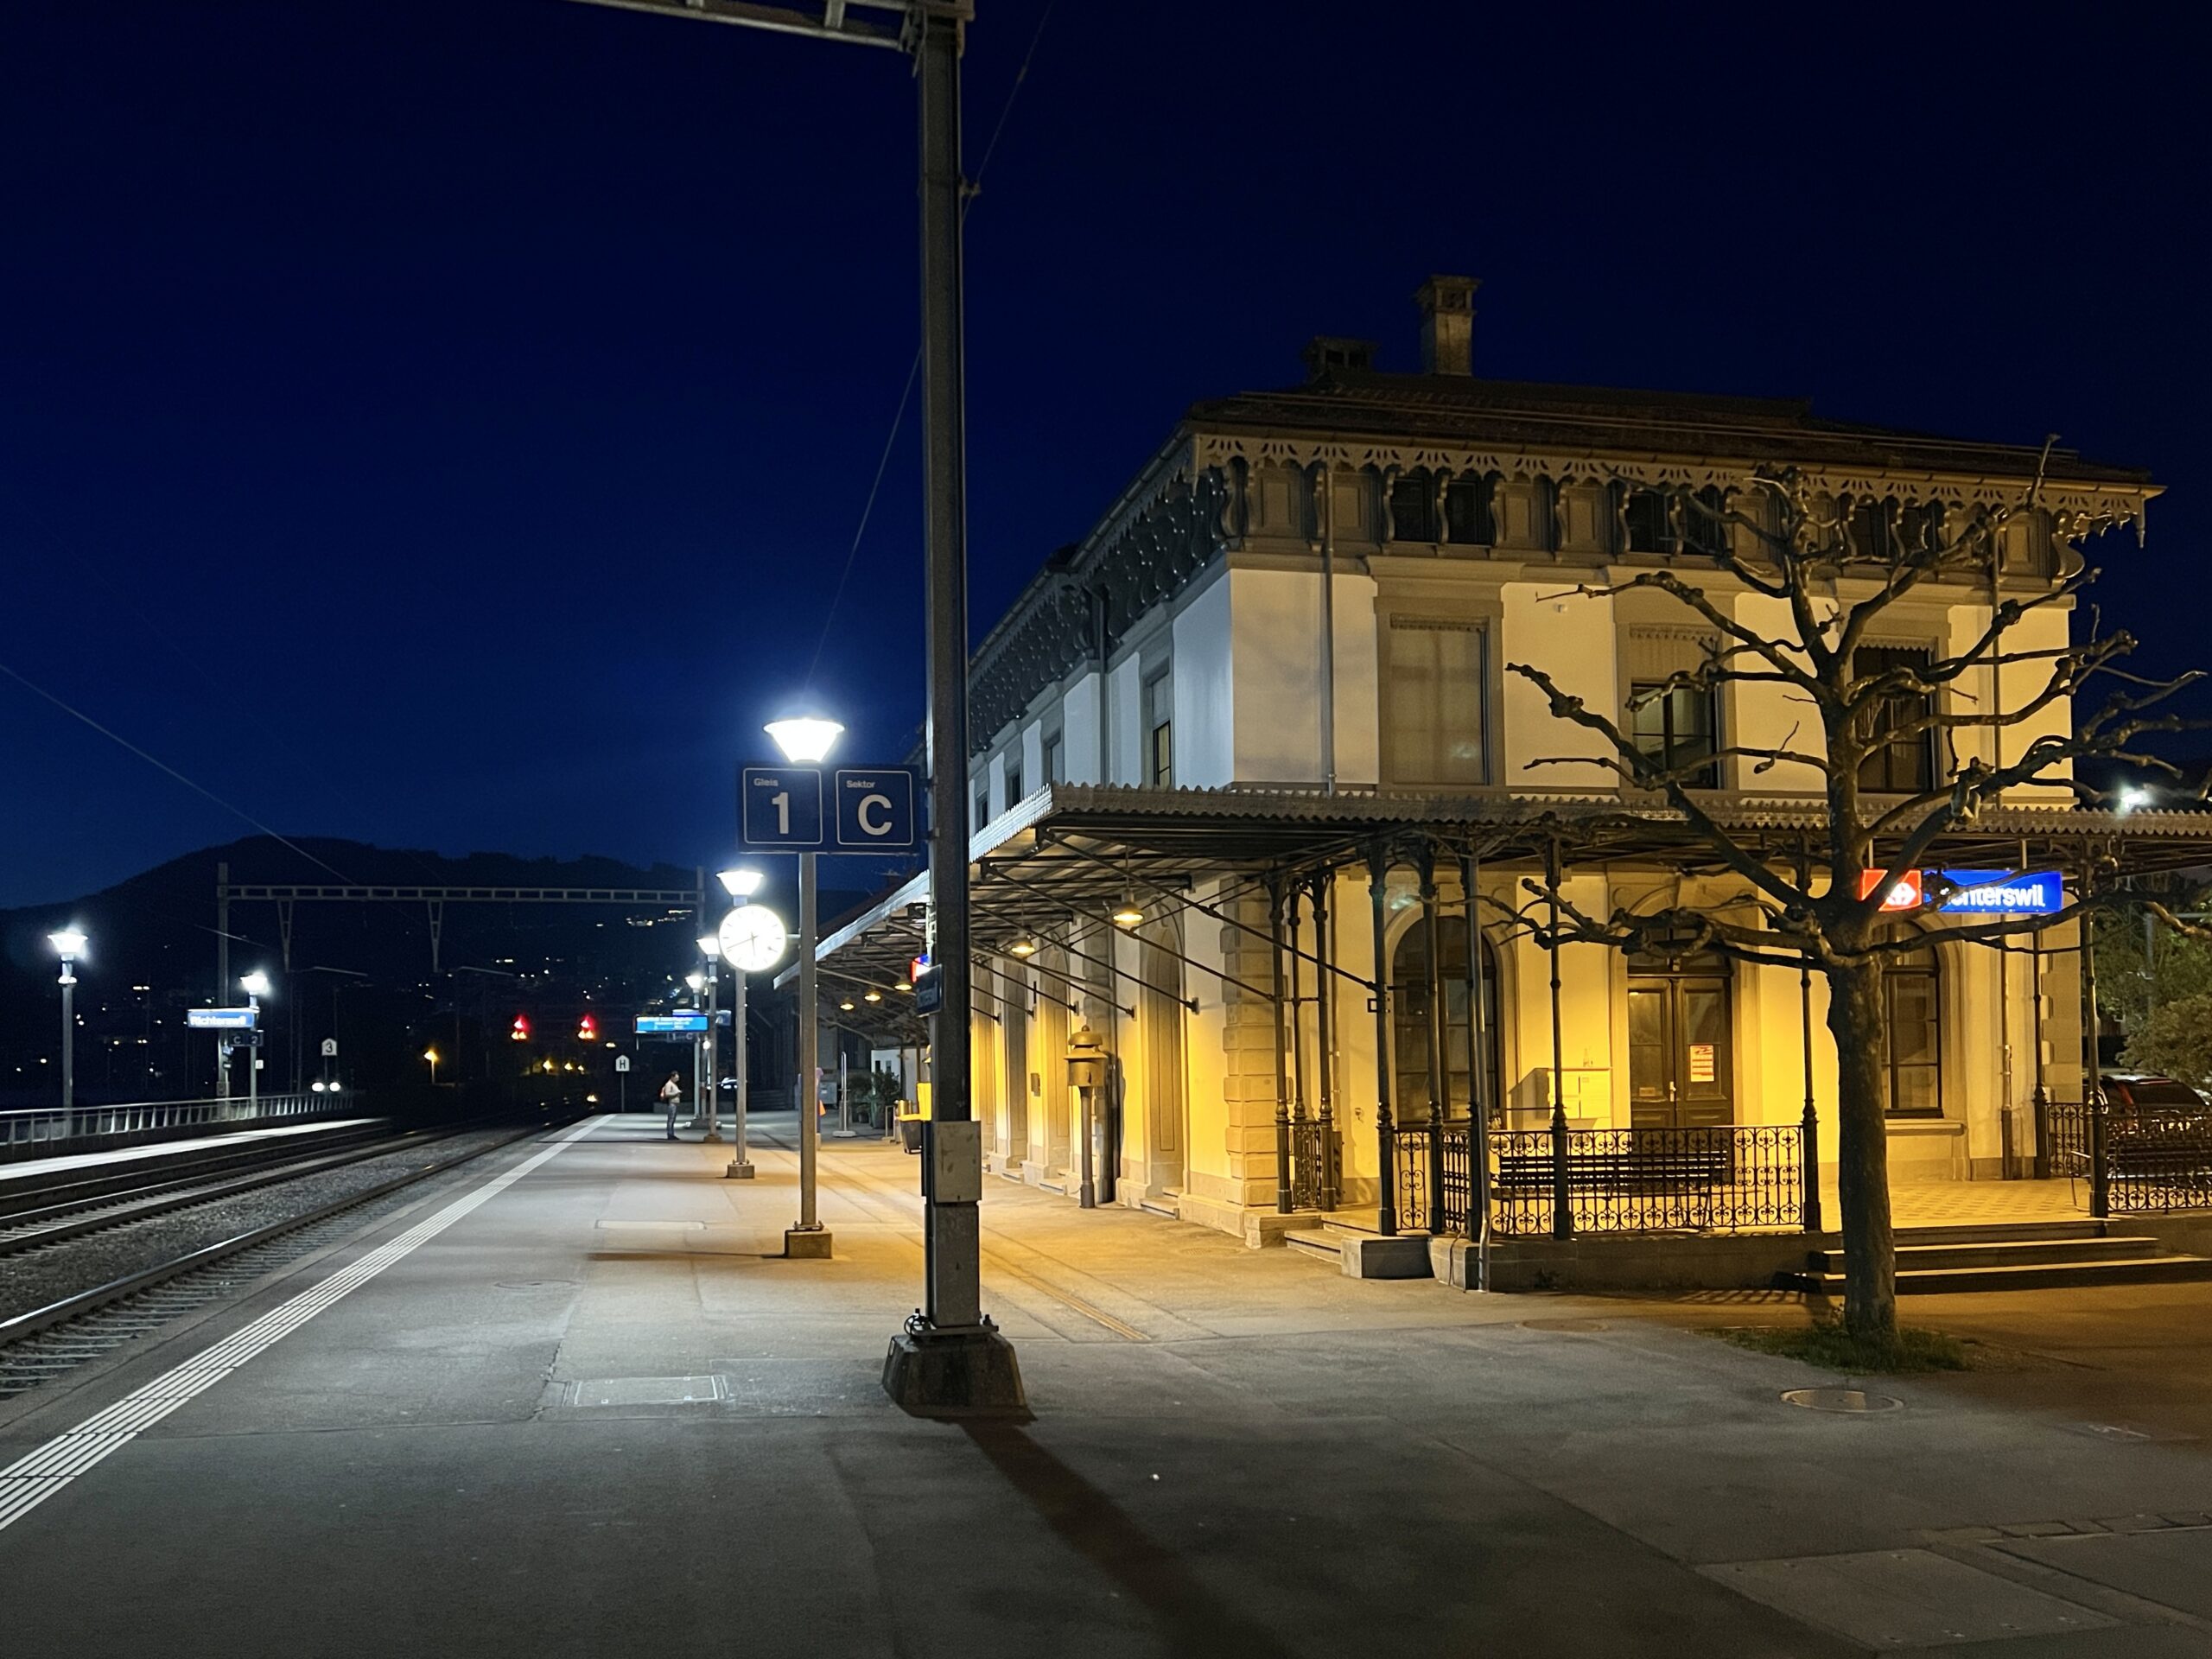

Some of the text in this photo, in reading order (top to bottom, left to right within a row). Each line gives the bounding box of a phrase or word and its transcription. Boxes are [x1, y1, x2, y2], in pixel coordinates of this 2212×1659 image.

[753, 778, 779, 786] Gleis
[846, 779, 875, 788] Sektor
[772, 792, 789, 835] 1
[858, 794, 893, 836] C
[325, 1041, 333, 1053] 3
[619, 1058, 626, 1070] H
